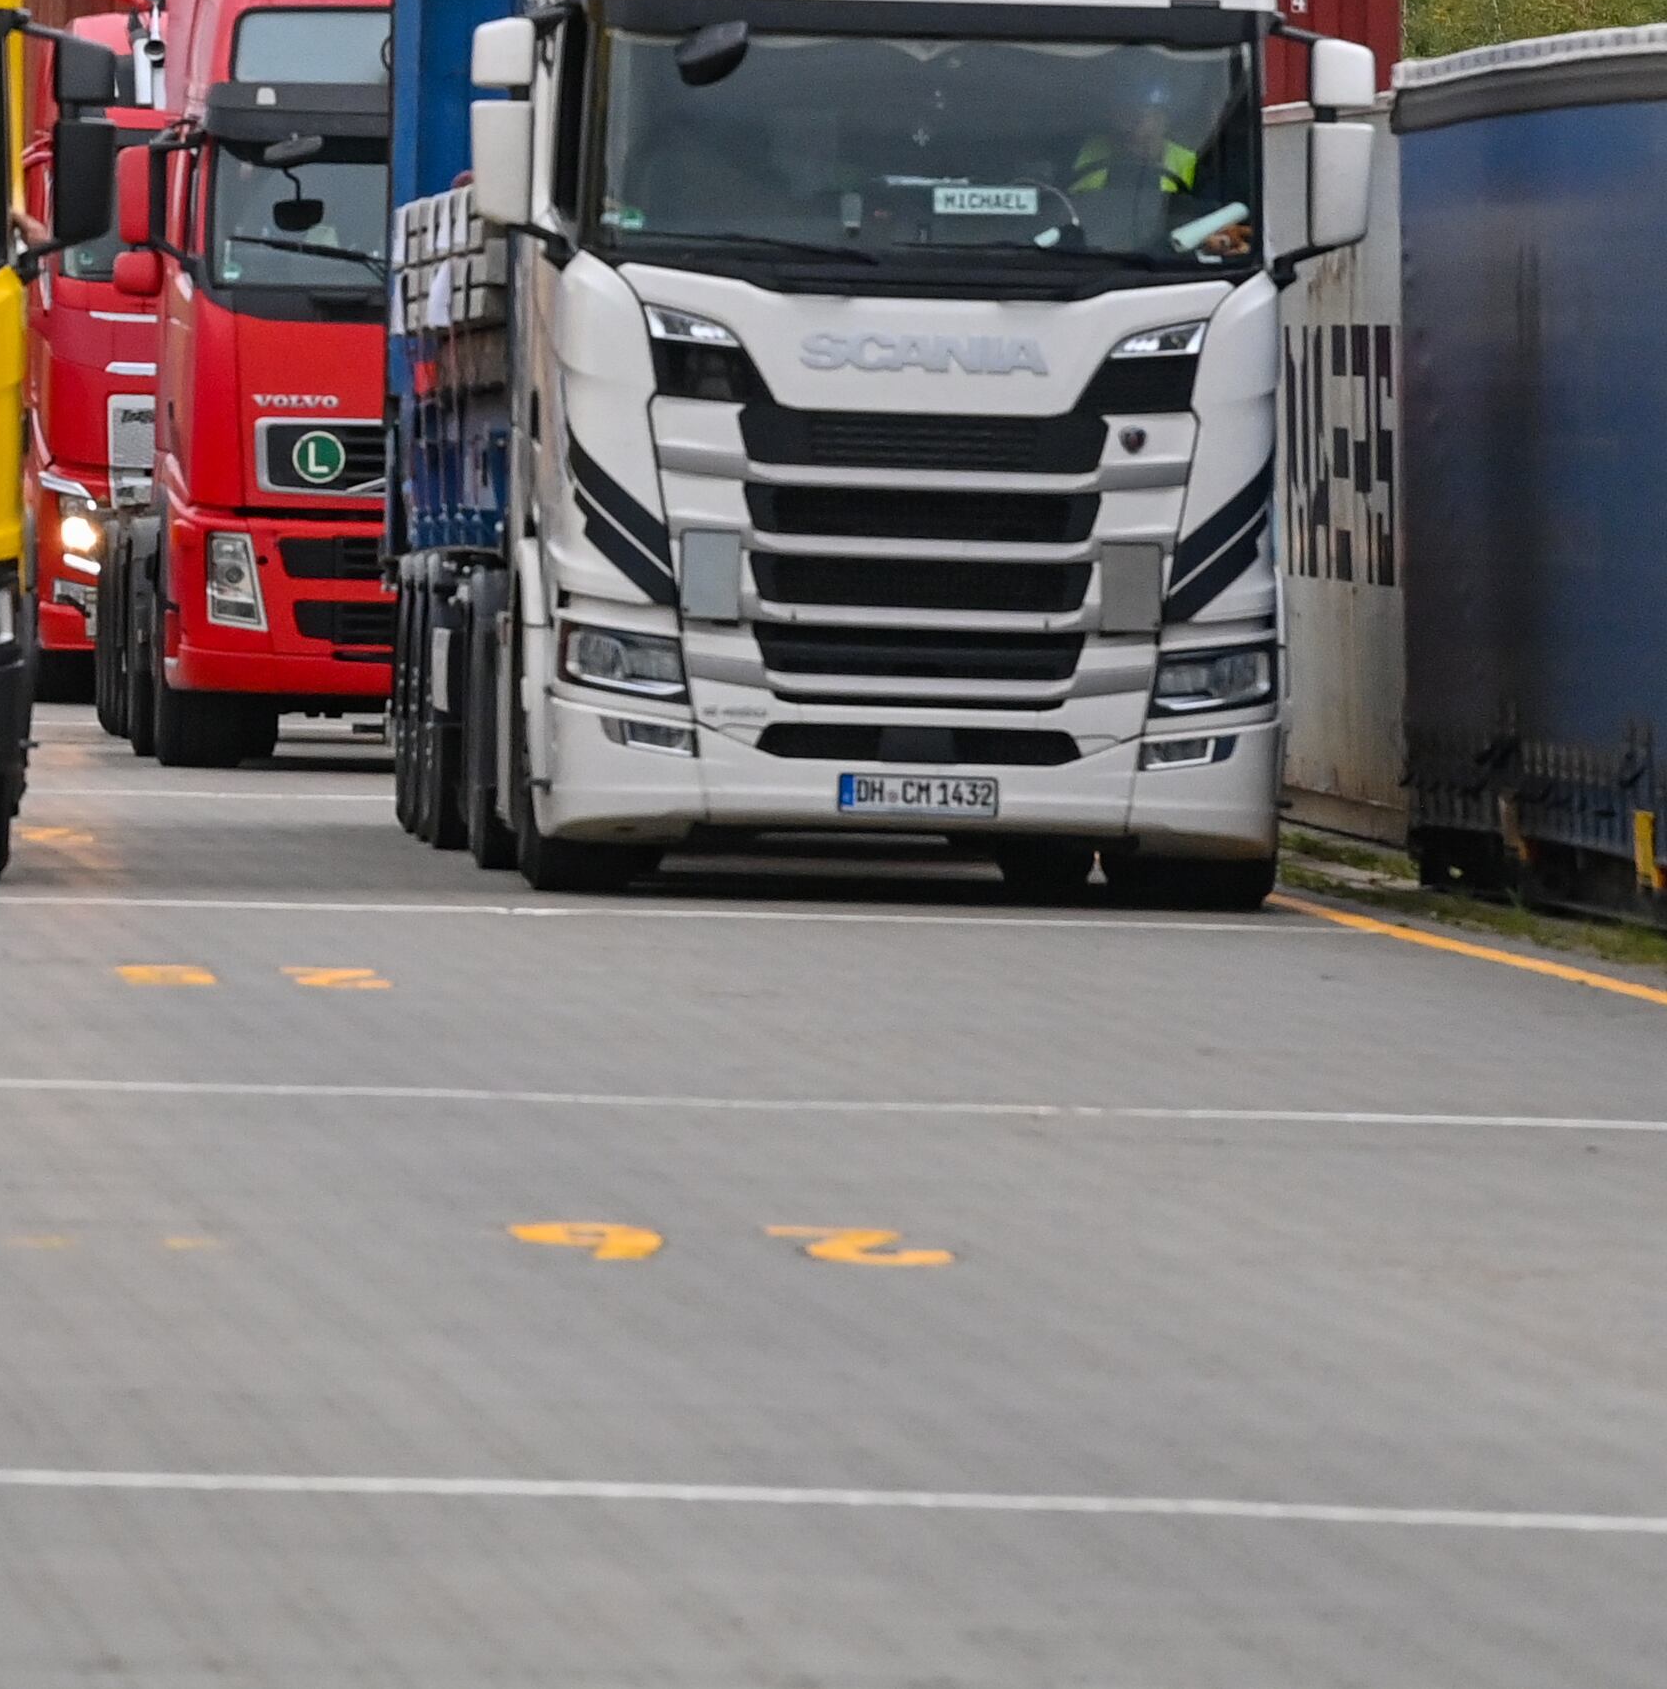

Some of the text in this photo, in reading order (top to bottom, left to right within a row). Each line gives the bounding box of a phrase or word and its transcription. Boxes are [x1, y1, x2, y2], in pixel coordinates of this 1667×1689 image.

[944, 194, 1027, 211] MICHAEL
[799, 334, 1050, 377] SCANIA
[252, 394, 340, 408] VOLVO
[307, 441, 330, 473] L
[857, 780, 993, 807] DH CM 1432
